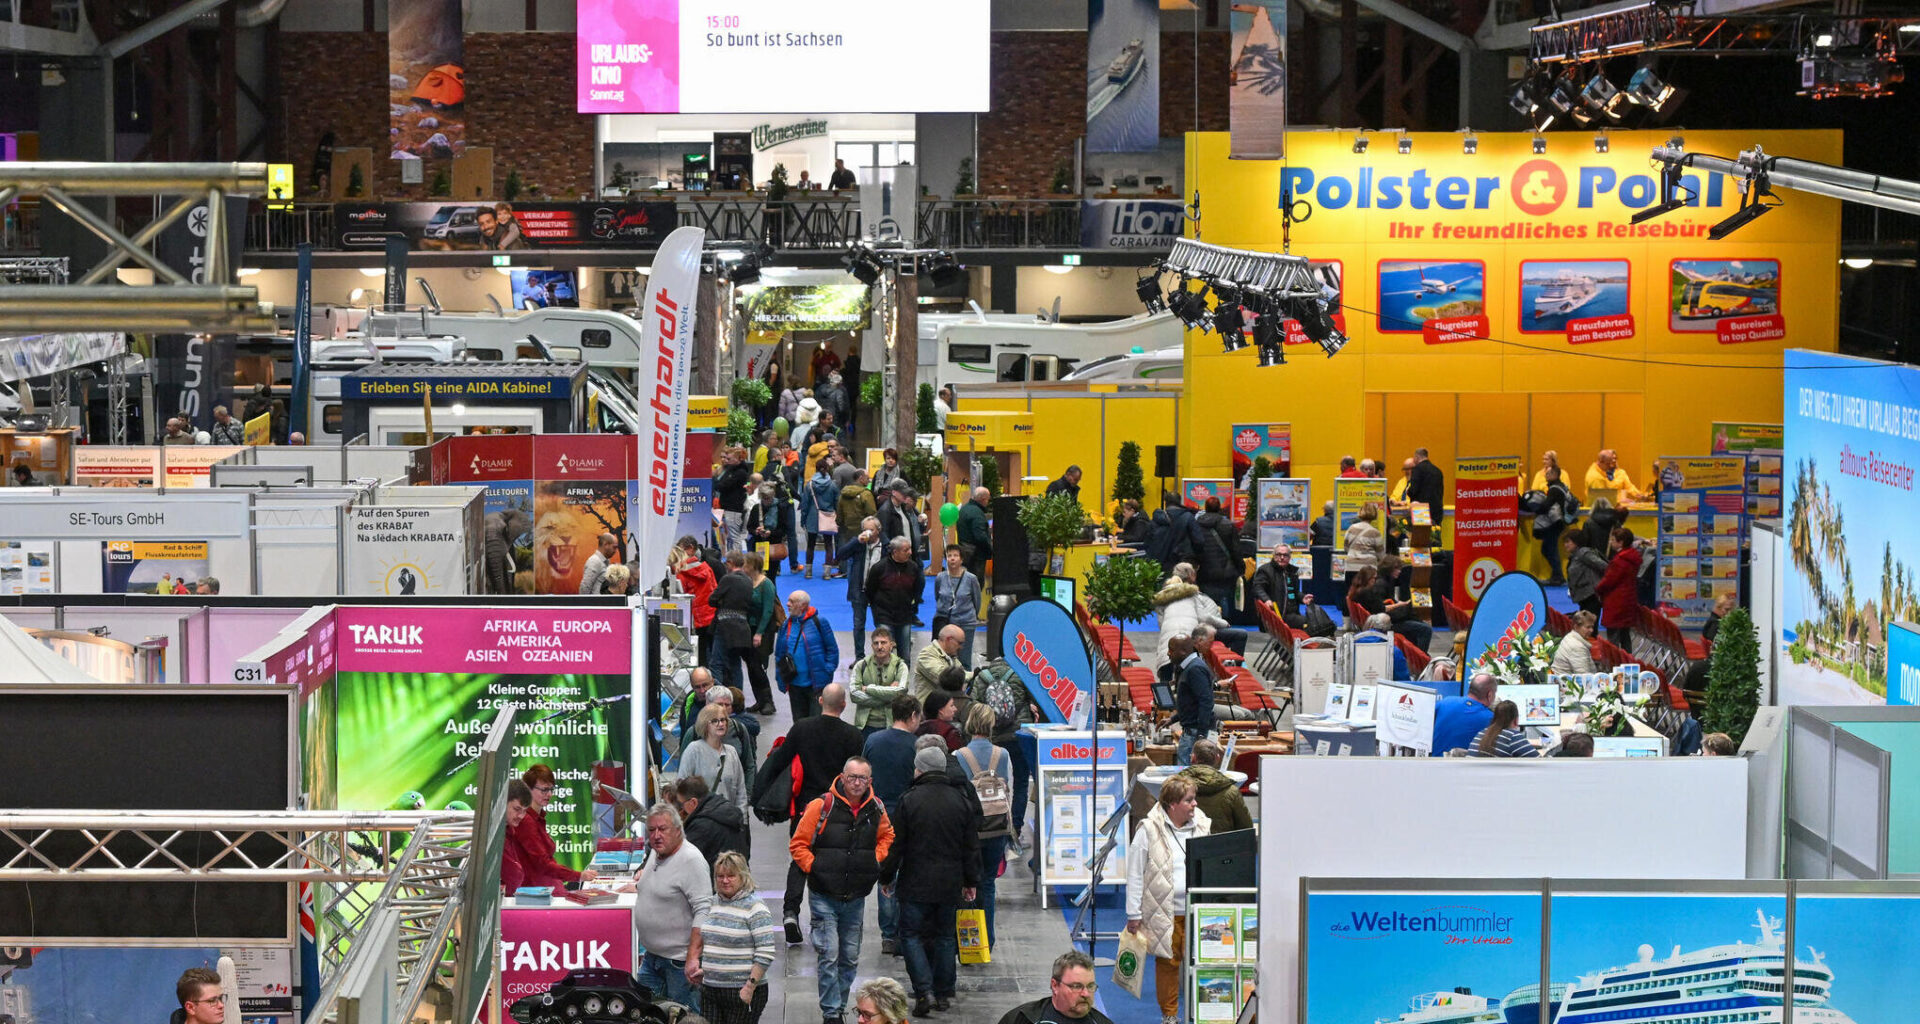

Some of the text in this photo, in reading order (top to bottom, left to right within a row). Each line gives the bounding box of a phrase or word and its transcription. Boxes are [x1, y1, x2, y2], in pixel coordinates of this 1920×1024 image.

[706, 16, 740, 29] 15:00
[706, 32, 843, 47] So bunt ist Sachsen
[591, 44, 653, 64] URLAUBS-
[591, 66, 622, 85] KINO
[590, 89, 625, 103] Sonntag
[751, 118, 829, 149] Wernesgrüner
[1277, 166, 1501, 210] Polster
[349, 211, 387, 220] malibu
[1388, 221, 1425, 240] Ihr
[1432, 220, 1589, 241] freundliches
[1109, 237, 1179, 248] CARAVANI
[1434, 320, 1479, 332] Flugreisen
[1573, 319, 1630, 331] Kreuzfahrten
[1730, 320, 1773, 331] Busreisen
[1438, 330, 1476, 341] weltweit
[1572, 328, 1633, 342] zum Bestpreis
[1721, 328, 1784, 342] in top Qualität
[677, 337, 687, 377] ganze
[360, 382, 552, 395] Erleben Sie eine AIDA Kabine!
[675, 380, 683, 401] die
[648, 287, 679, 517] eberhardt
[1799, 387, 1814, 417] DER
[1814, 389, 1831, 421] WEG
[1832, 392, 1842, 424] ZU
[1842, 395, 1868, 430] IHREM
[1868, 400, 1901, 437] URLAUB
[671, 420, 682, 465] reisen.
[481, 459, 513, 468] DIAMIR
[569, 458, 605, 468] DIAMIR
[1458, 463, 1489, 472] Polster
[1840, 443, 1915, 492] alltours Reisecenter
[501, 487, 529, 496] TOUREN
[566, 488, 594, 496] AFRIKA
[667, 469, 681, 517] Richtig
[1456, 487, 1517, 499] Sensationell!
[698, 495, 707, 503] 14
[69, 512, 165, 526] SE-Tours GmbH
[357, 508, 430, 519] Auf den Spuren
[357, 522, 414, 531] des KRABAT
[1456, 520, 1517, 530] TAGESFAHRTEN
[357, 534, 370, 542] Na
[410, 533, 455, 542] KRABATA
[1471, 539, 1502, 548] schon ab
[109, 552, 131, 560] tours
[483, 620, 613, 633] AFRIKA EUROPA
[348, 624, 424, 645] TARUK
[497, 635, 563, 648] AMERIKA
[465, 649, 593, 663] ASIEN OZEANIEN
[234, 668, 262, 681] C31
[488, 683, 582, 697] Kleine Gruppen:
[477, 699, 491, 710] 12
[528, 699, 588, 711] höchstens
[1050, 743, 1115, 760] alltours
[1329, 910, 1515, 933] die Weltenbummler
[1443, 934, 1514, 946] Ihr Urlaub
[501, 939, 612, 972] TARUK
